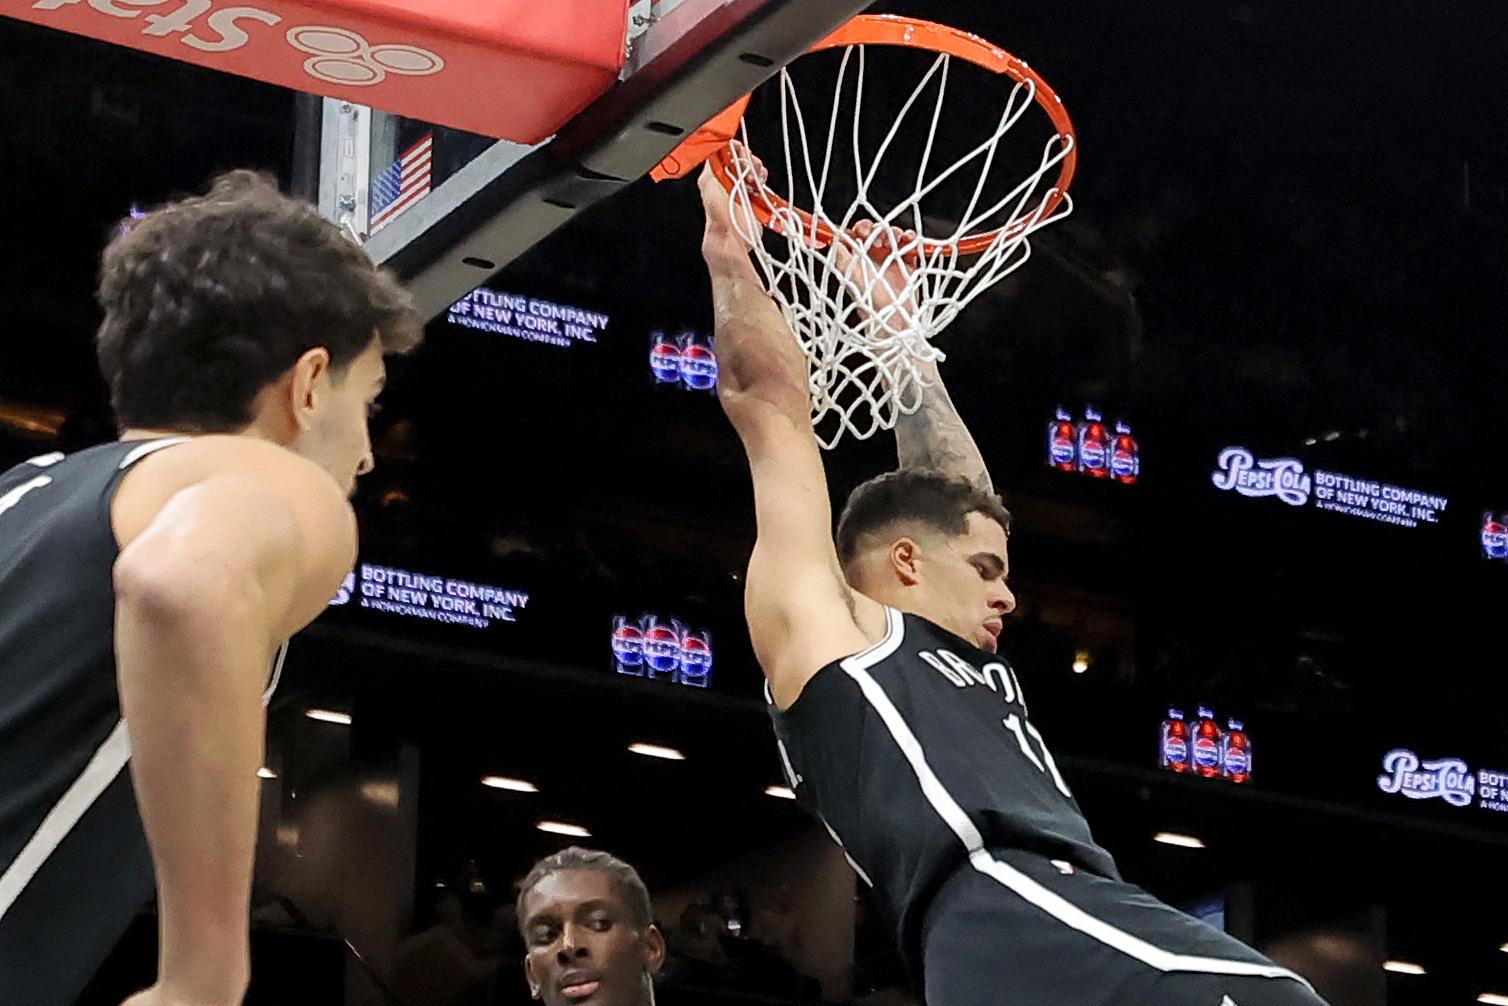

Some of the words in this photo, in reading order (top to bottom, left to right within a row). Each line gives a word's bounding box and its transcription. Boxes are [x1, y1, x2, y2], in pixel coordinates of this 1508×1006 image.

[463, 287, 527, 313] TTLING
[529, 297, 609, 330] COMPANY
[473, 304, 511, 325] NEW
[564, 323, 598, 343] INC.
[1314, 469, 1380, 498] BOTTLING
[1381, 484, 1448, 511] COMPANY
[1315, 486, 1335, 500] OF
[1336, 490, 1368, 508] NEW
[361, 565, 443, 592] BOTTLING
[446, 578, 529, 608] COMPANY
[361, 582, 385, 597] OF
[387, 586, 427, 606] NEW
[482, 603, 516, 622] INC.
[1479, 786, 1499, 800] OF
